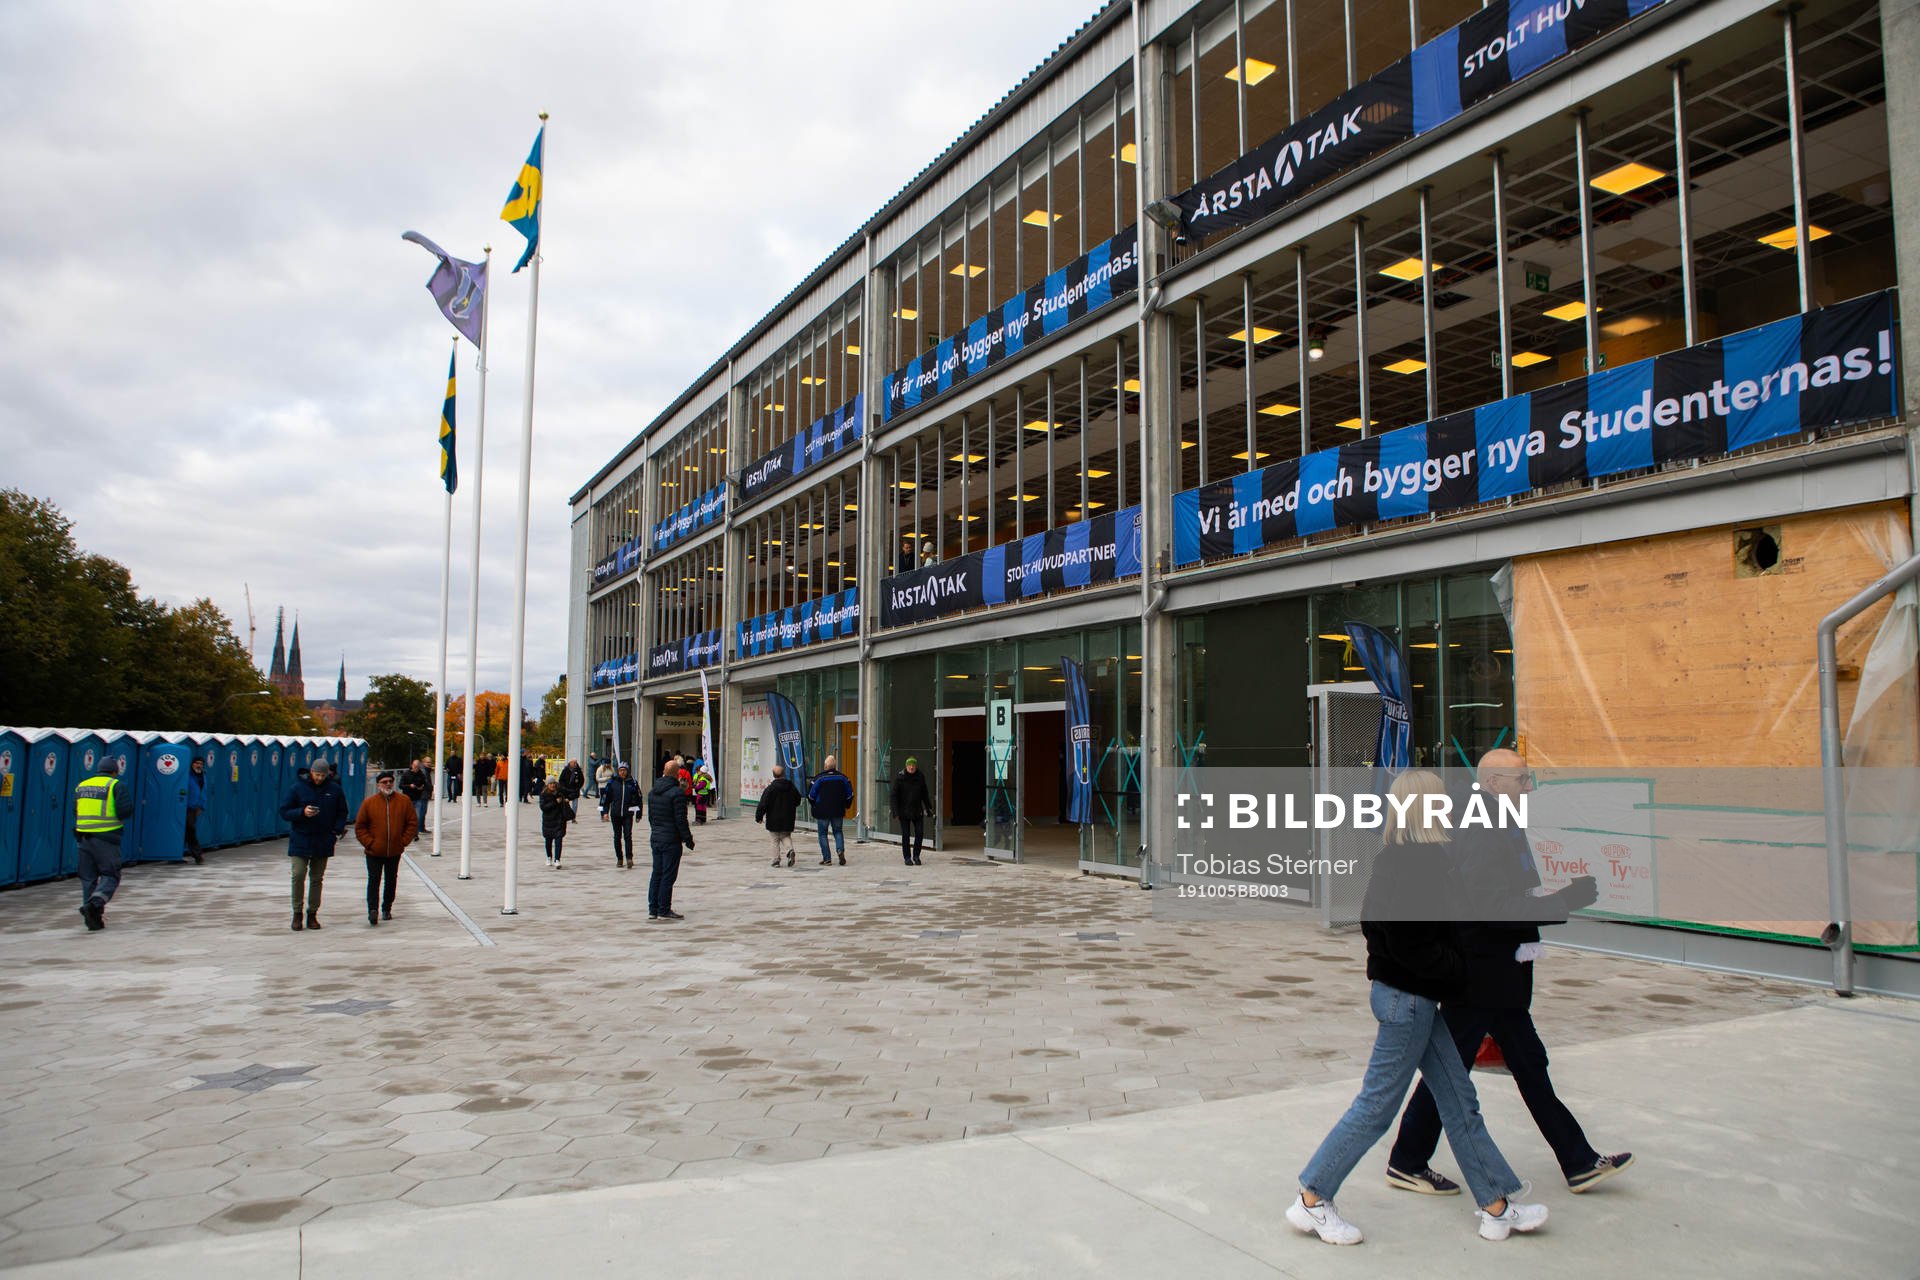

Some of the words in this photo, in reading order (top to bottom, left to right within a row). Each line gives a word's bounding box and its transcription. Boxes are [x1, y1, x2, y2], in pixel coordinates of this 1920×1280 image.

[1463, 19, 1530, 78] STOLT
[1190, 166, 1272, 223] ÅRSTA
[1307, 104, 1364, 160] TAK
[890, 381, 900, 401] Vi
[901, 376, 914, 395] är
[916, 361, 939, 388] med
[941, 348, 960, 374] och
[961, 327, 1004, 364] bygger
[1008, 312, 1029, 339] nya
[1032, 241, 1138, 321] Studenternas!
[1198, 506, 1221, 535] Vi
[1227, 498, 1248, 529] är
[1252, 480, 1300, 522] med
[1307, 467, 1353, 505] och
[1363, 449, 1477, 501] bygger
[1487, 428, 1546, 473] nya
[1558, 329, 1893, 450] Studenternas!
[1007, 563, 1031, 583] STOLT
[1031, 543, 1117, 575] HUVUDPARTNER
[891, 585, 928, 610] ÅRSTA
[938, 572, 967, 598] TAK
[741, 633, 749, 646] Vi
[767, 622, 779, 638] och
[779, 620, 802, 638] bygger
[813, 604, 861, 627] Studenterna
[997, 706, 1006, 727] B
[1542, 855, 1589, 876] Tyvek
